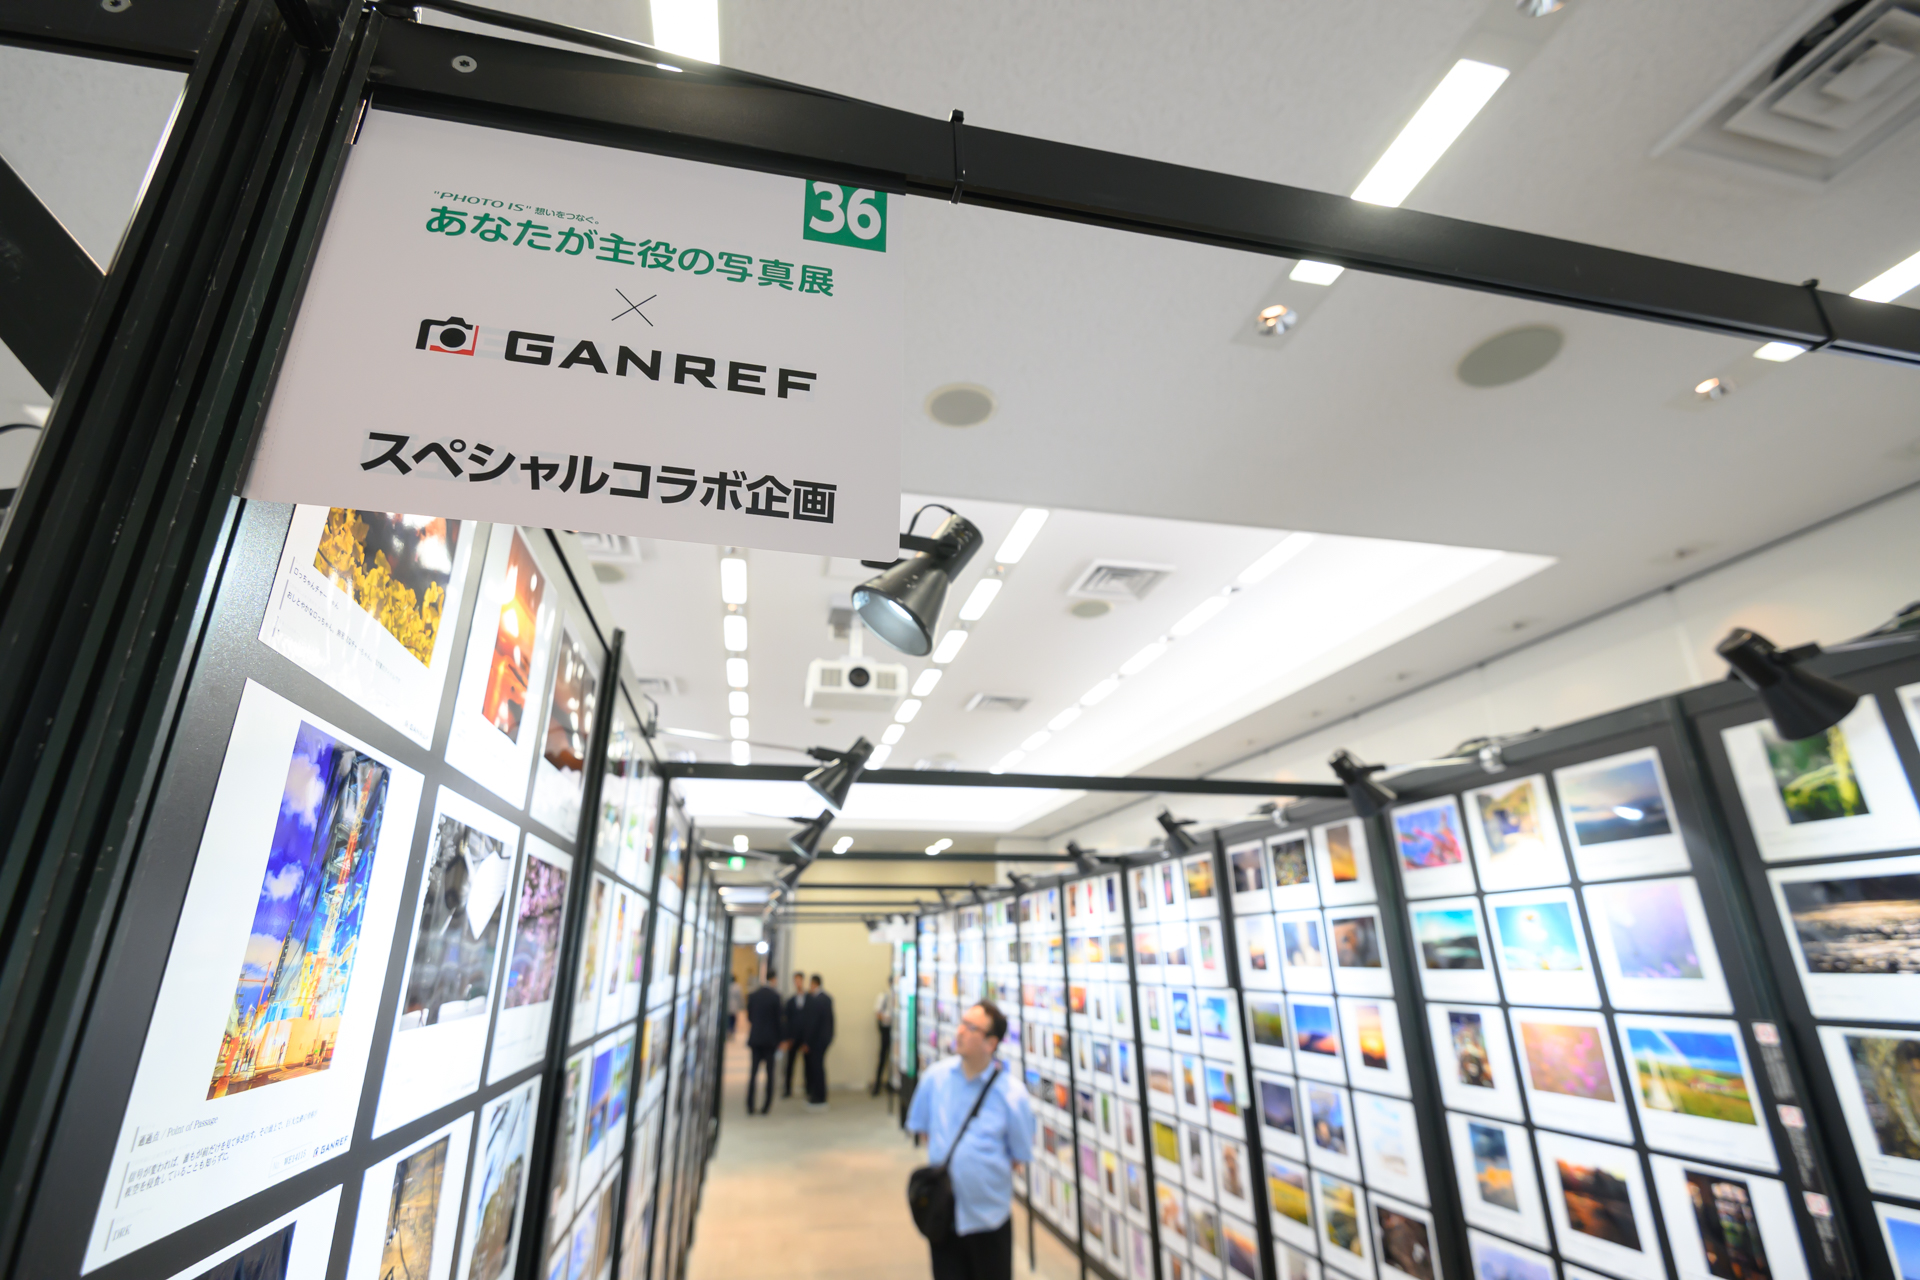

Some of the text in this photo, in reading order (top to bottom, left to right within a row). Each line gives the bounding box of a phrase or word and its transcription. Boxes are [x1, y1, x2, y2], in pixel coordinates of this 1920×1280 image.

[434, 190, 504, 209] "PHOTO
[534, 206, 600, 225] 想いをつなぐ。
[808, 180, 882, 241] 36
[426, 206, 835, 297] あなたが主役の写真展
[504, 329, 818, 399] GANREF
[360, 431, 838, 525] スペシャルコラボ企画
[320, 1134, 349, 1155] GANREF
